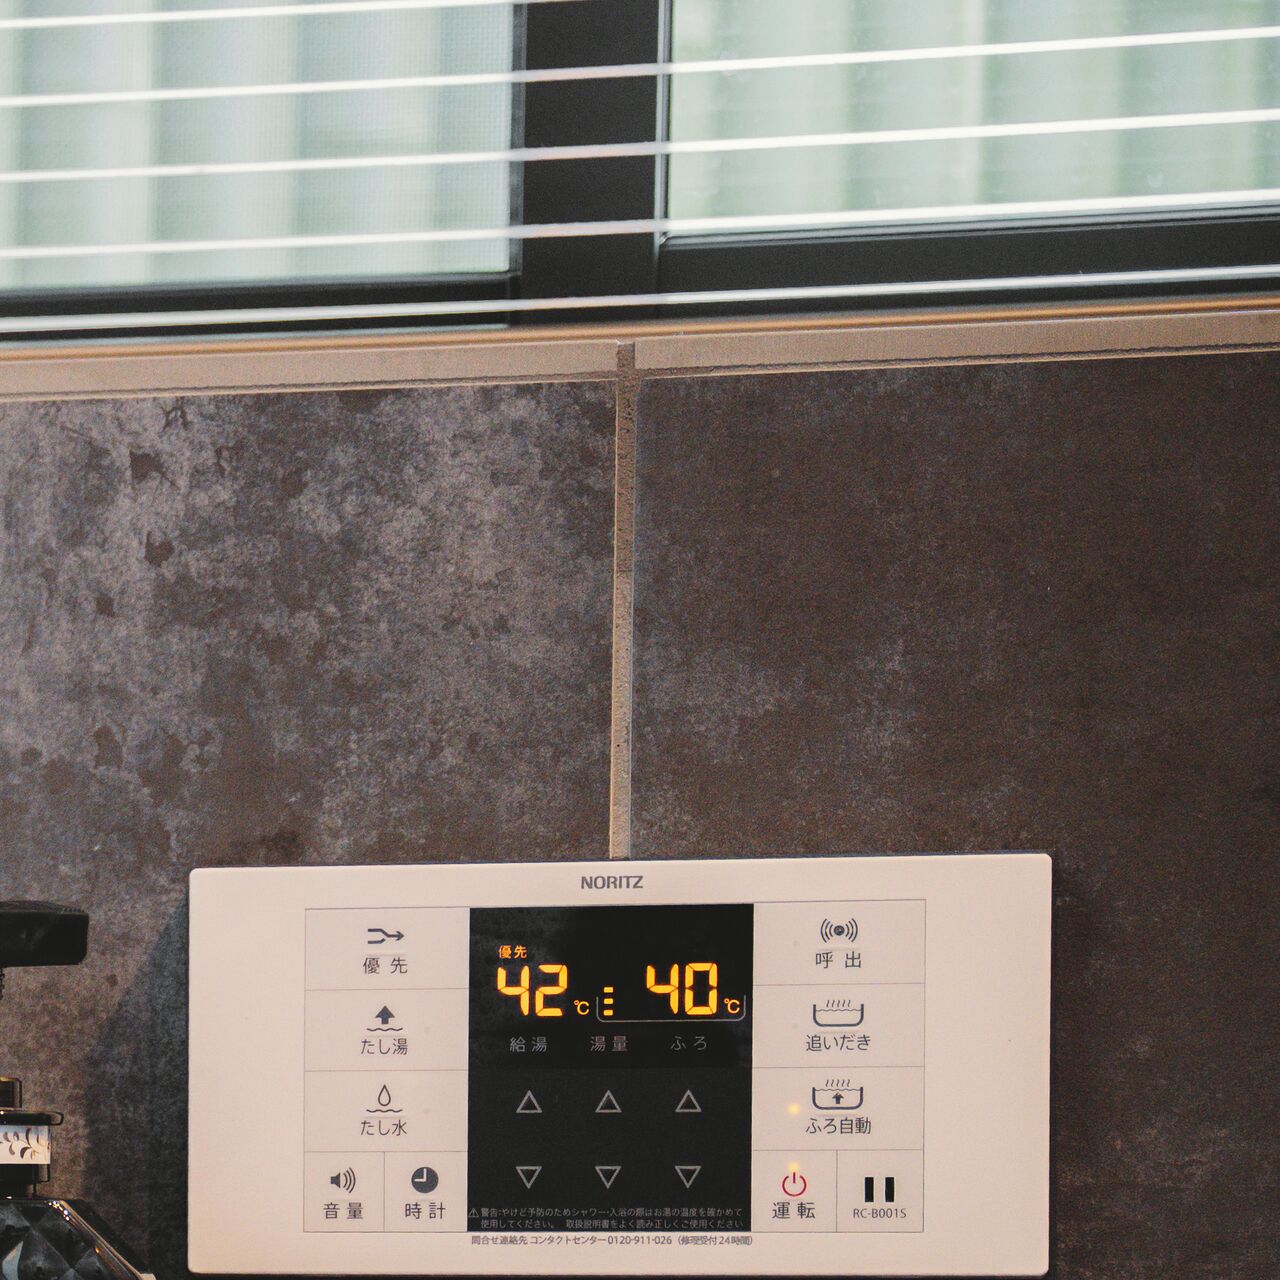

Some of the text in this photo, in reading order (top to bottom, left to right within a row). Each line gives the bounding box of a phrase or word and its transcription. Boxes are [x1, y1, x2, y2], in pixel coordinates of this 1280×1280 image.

[580, 875, 644, 890] NORITZ
[498, 945, 527, 959] 優先
[815, 950, 862, 969] 呼出
[362, 956, 408, 975] 優先
[497, 964, 568, 1017] 42
[646, 962, 718, 1016] 40
[360, 1037, 409, 1056] たし湯
[509, 1036, 549, 1053] 給湯
[589, 1035, 629, 1052] 湯量
[670, 1035, 708, 1051] ふろ
[805, 1033, 872, 1052] 追いだき
[360, 1119, 408, 1137] たし水
[805, 1116, 872, 1135] ふろ自動
[323, 1201, 364, 1220] 音量
[404, 1201, 446, 1220] 時計
[771, 1201, 816, 1220] 運転
[852, 1207, 908, 1219] RC-B001S
